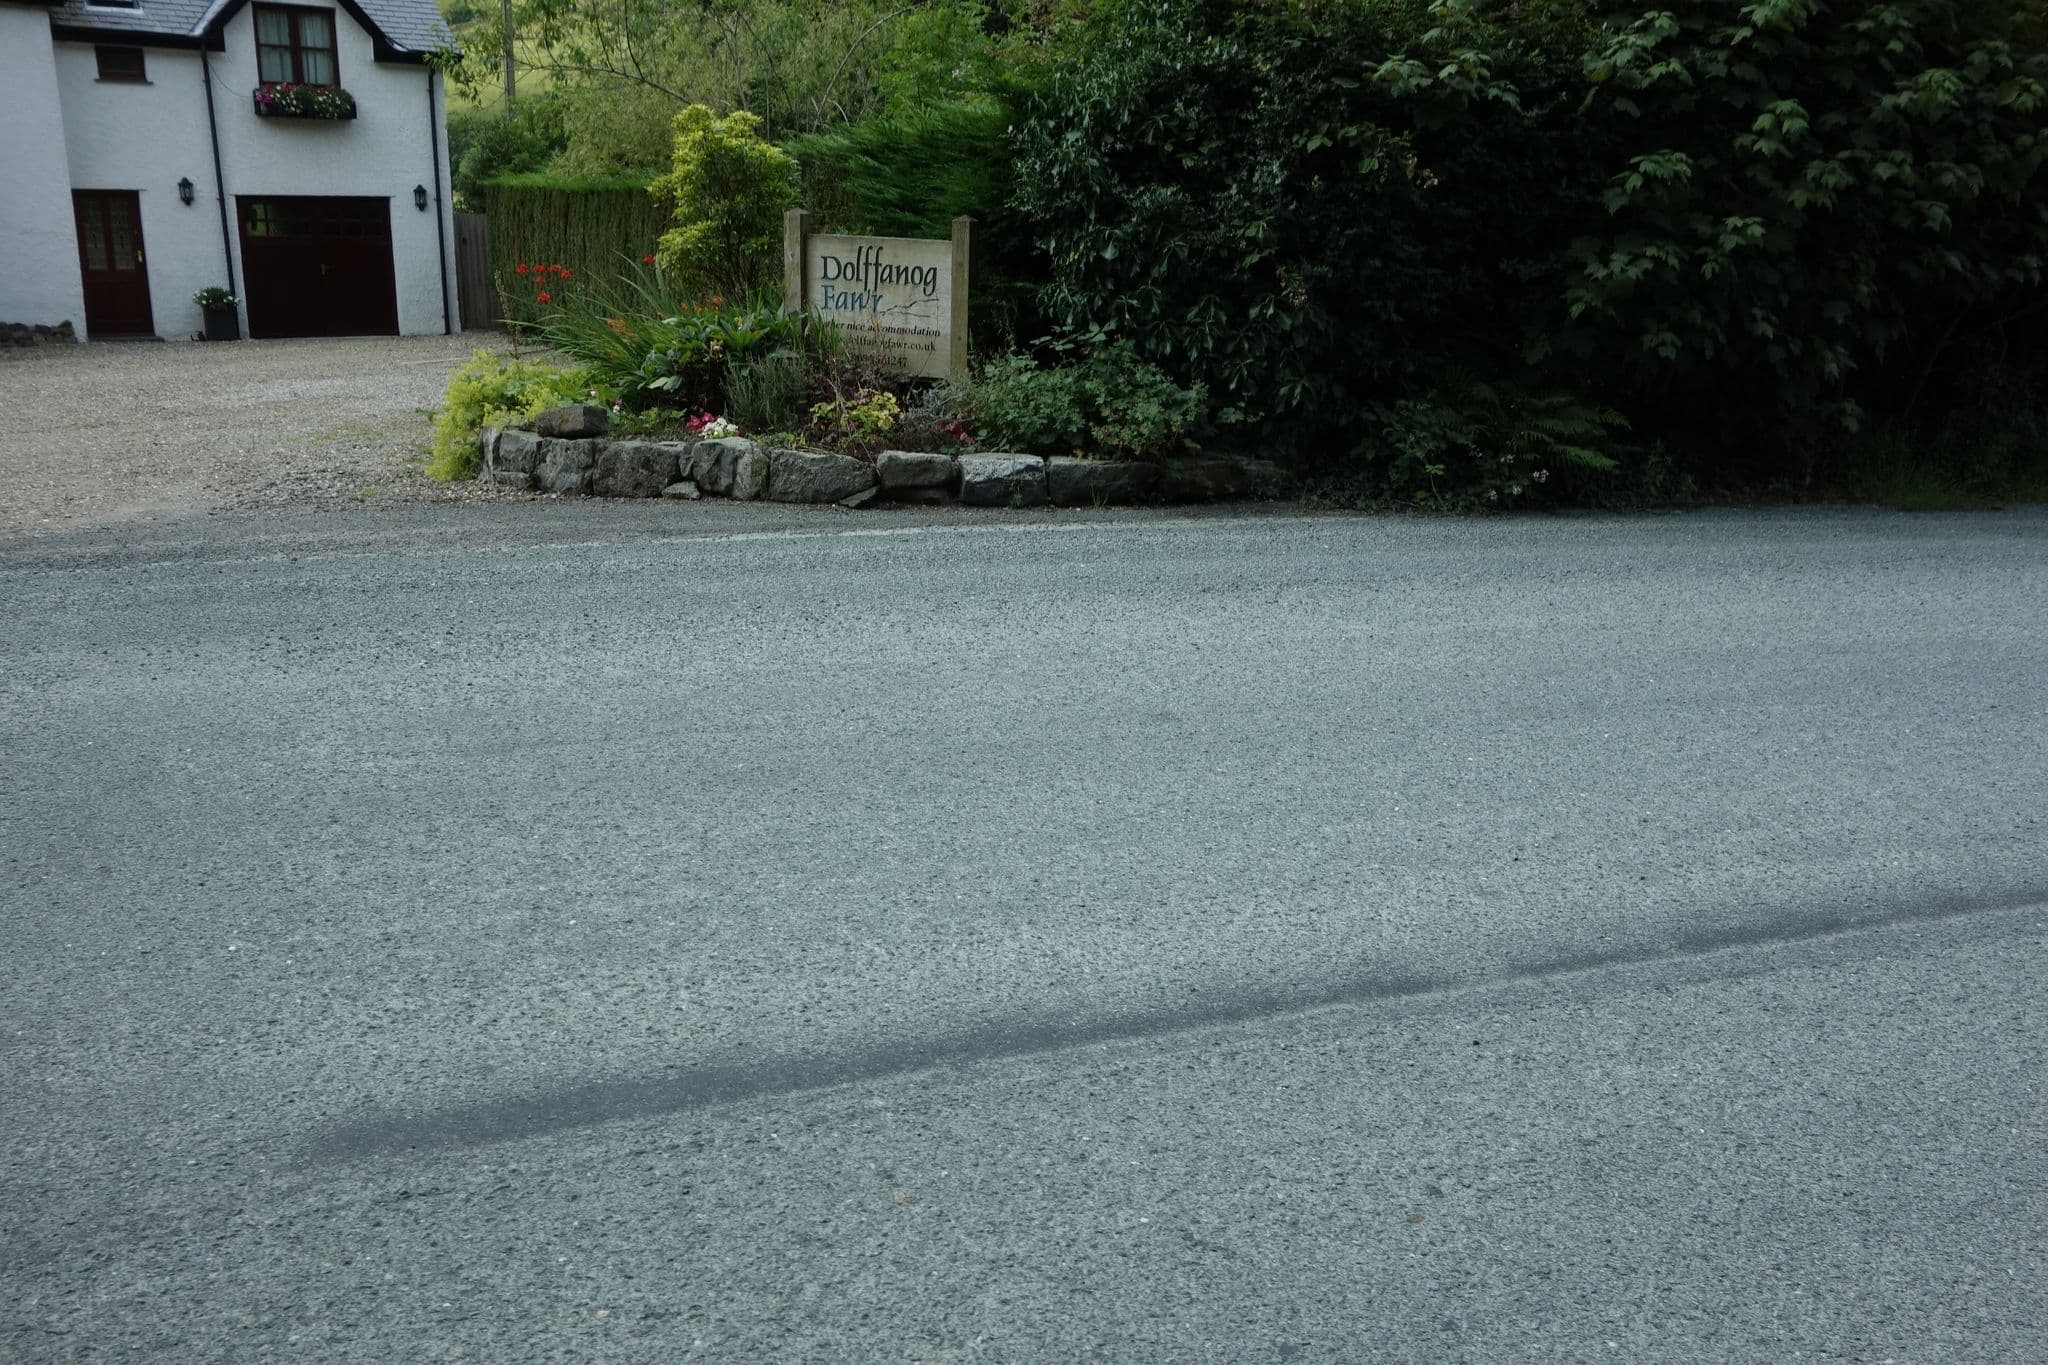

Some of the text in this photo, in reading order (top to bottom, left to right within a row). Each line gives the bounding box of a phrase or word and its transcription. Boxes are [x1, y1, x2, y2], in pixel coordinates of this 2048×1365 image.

[820, 245, 938, 297] Dolffanog
[821, 284, 883, 313] Fawr
[846, 322, 865, 332] nice
[867, 324, 941, 337] acommodation
